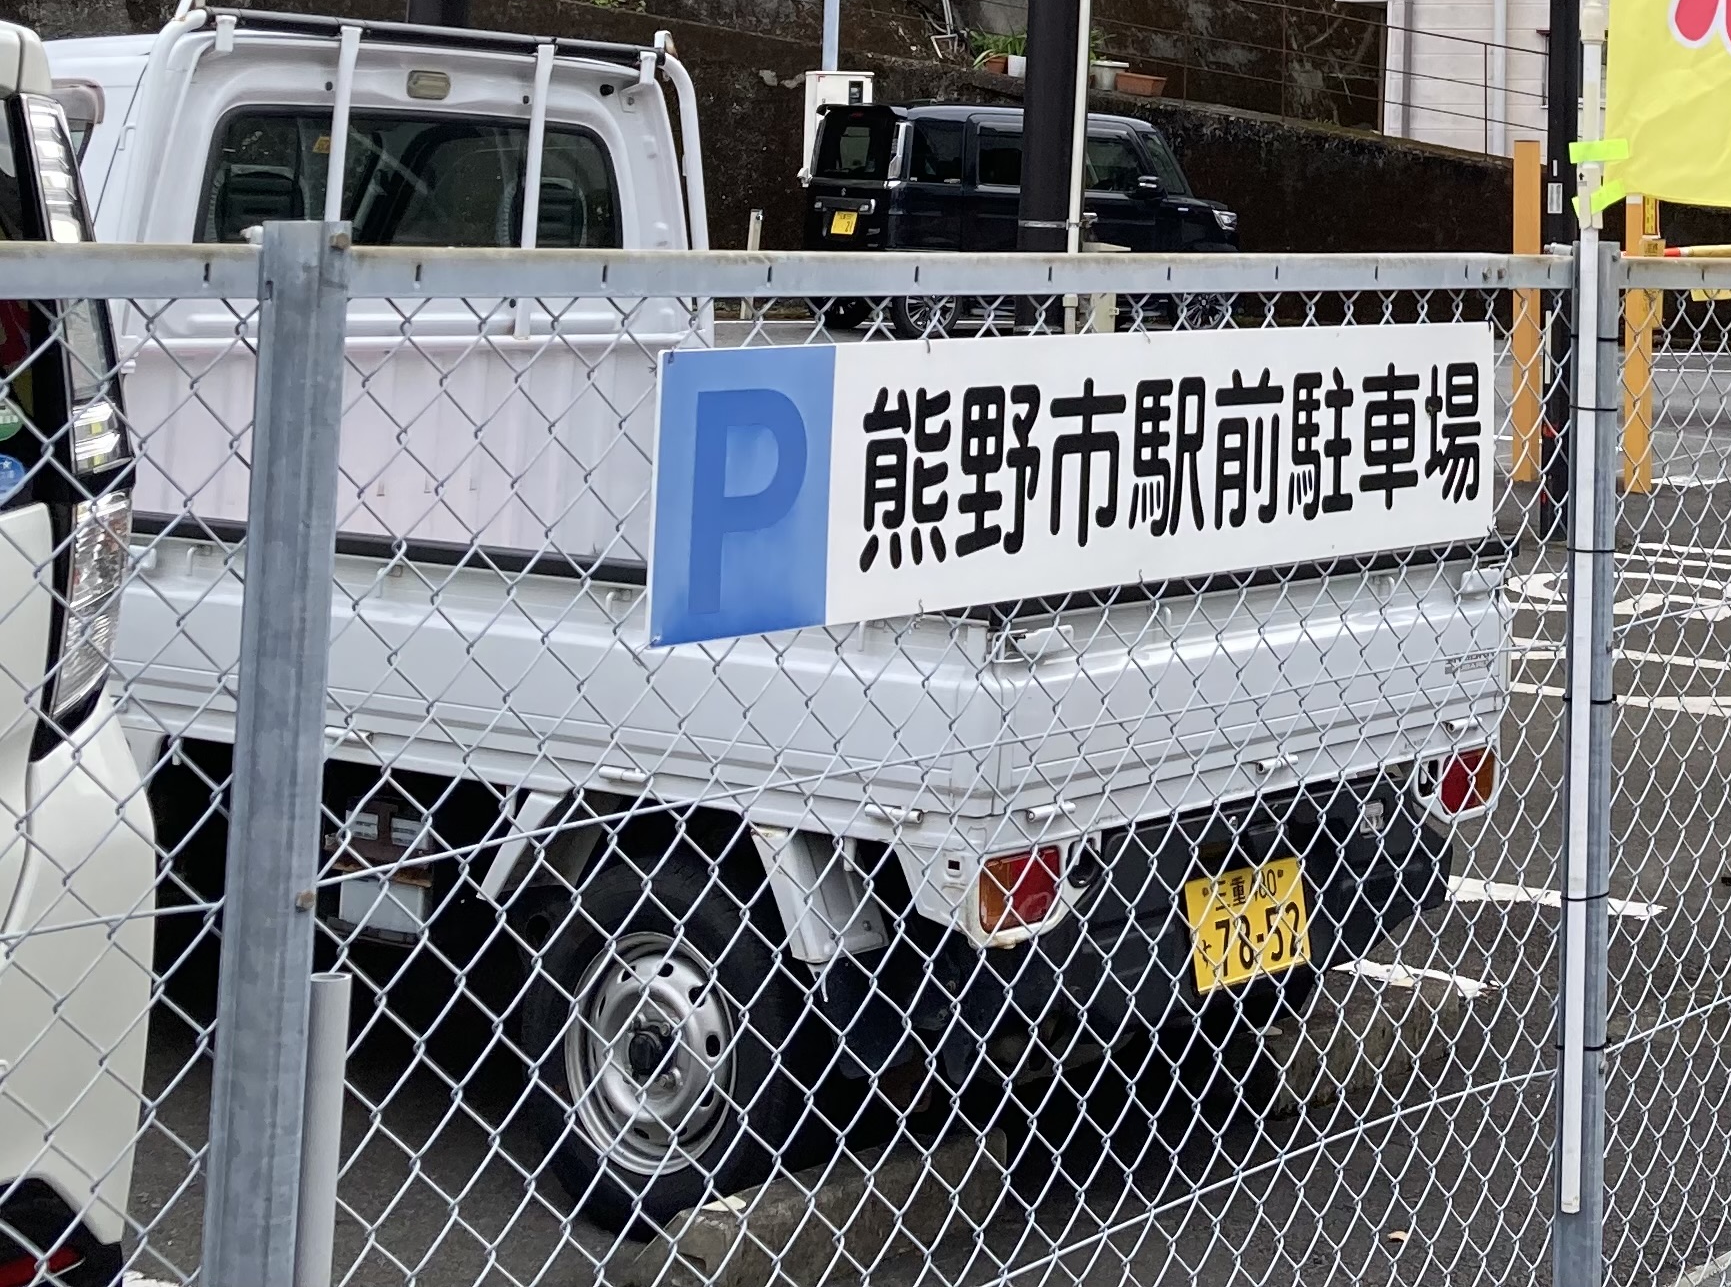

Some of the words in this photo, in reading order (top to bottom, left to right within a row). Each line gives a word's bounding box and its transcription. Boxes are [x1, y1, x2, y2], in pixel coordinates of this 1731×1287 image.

[688, 388, 807, 615] P
[859, 361, 1481, 573] 熊野市駅前駐車場
[1212, 876, 1247, 911] 三重
[1215, 901, 1305, 978] 78-52
